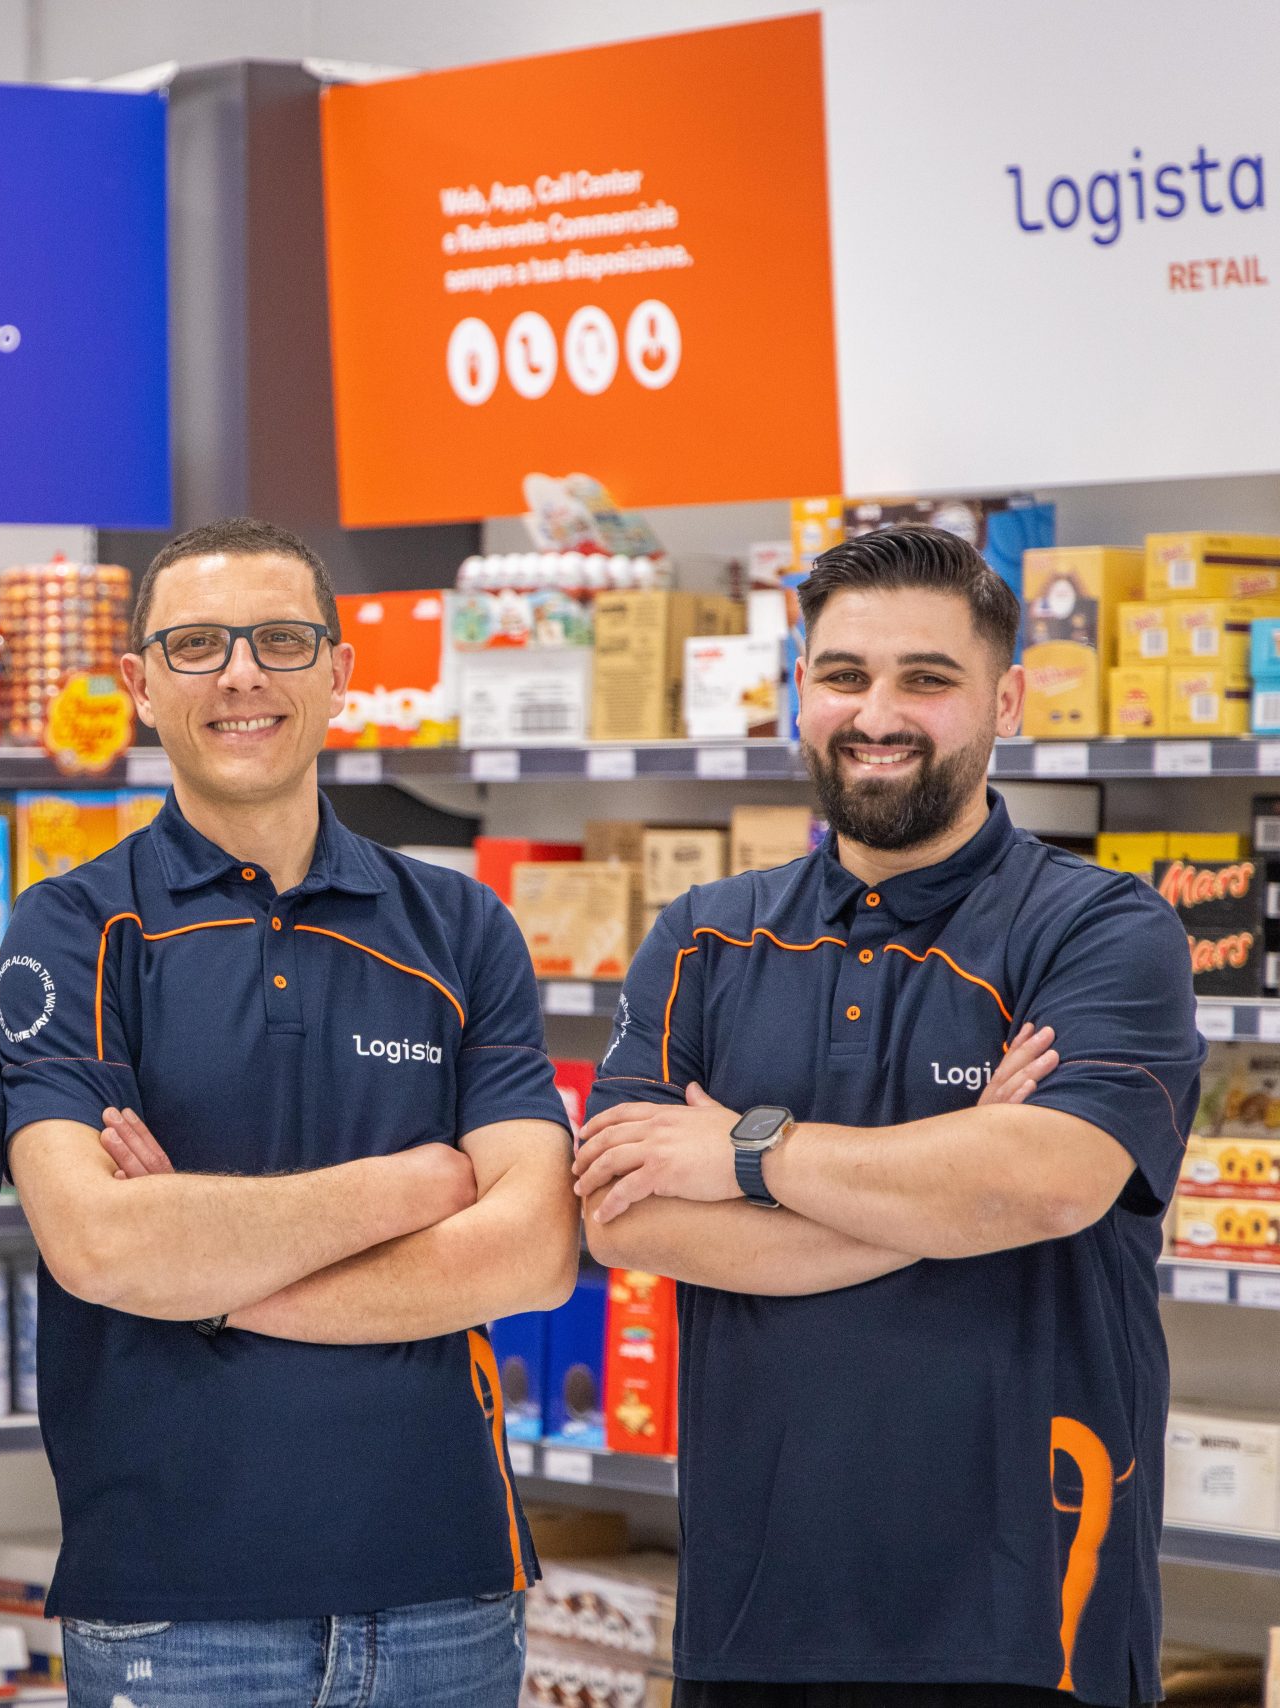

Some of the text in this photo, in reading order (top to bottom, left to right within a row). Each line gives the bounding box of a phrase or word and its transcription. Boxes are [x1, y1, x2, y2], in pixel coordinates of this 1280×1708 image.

[535, 172, 576, 205] Call
[1006, 145, 1266, 248] logista
[1169, 255, 1268, 293] RETAIL
[1158, 860, 1255, 908] Mars
[11, 955, 42, 972] ALONG
[1187, 931, 1254, 975] ars
[39, 968, 54, 992] THE
[44, 993, 56, 1016] WAY
[14, 1030, 30, 1043] THE
[29, 1013, 50, 1036] WAY
[353, 1035, 442, 1064] logista
